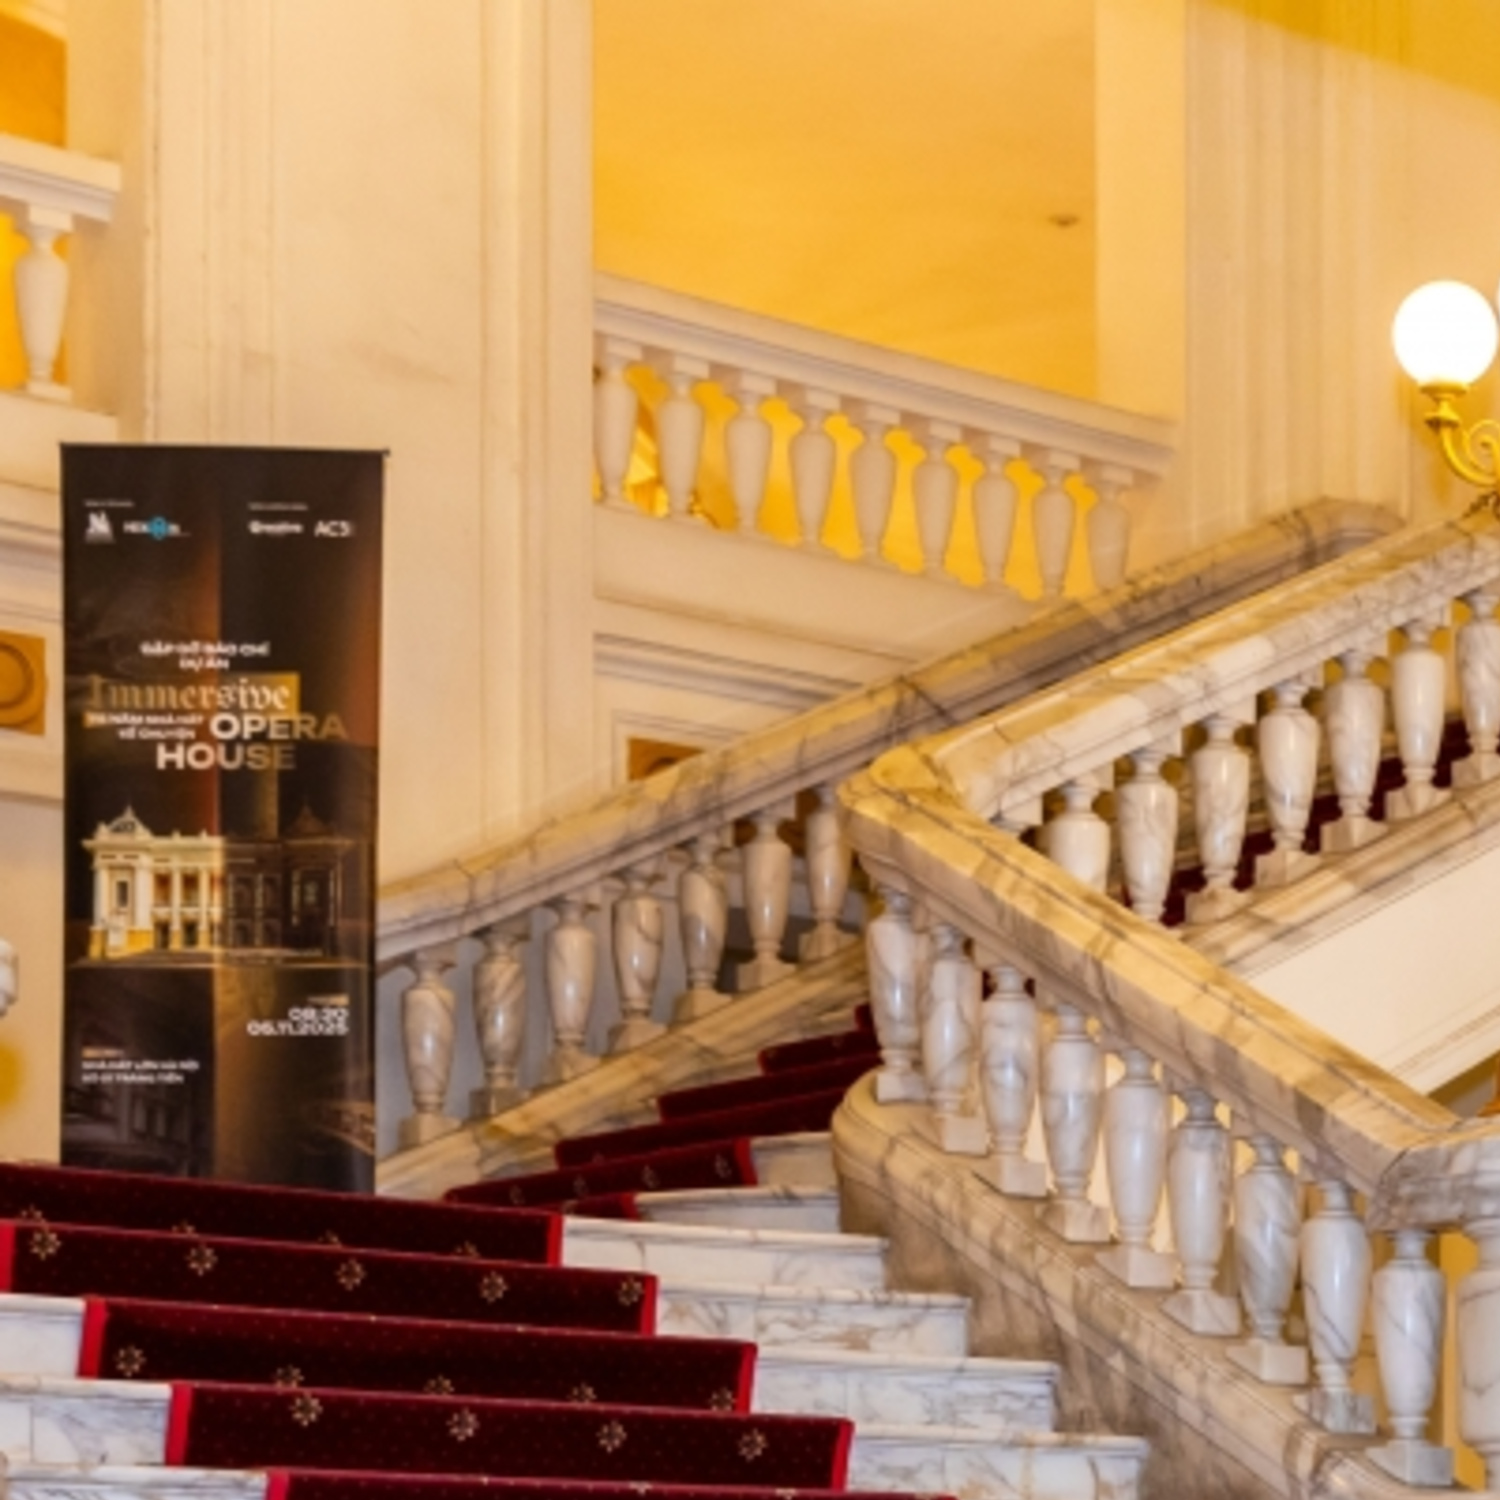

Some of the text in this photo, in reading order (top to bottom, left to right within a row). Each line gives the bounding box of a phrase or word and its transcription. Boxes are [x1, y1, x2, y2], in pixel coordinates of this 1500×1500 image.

[87, 673, 290, 710] Immersive
[209, 711, 348, 741] OPERA
[156, 742, 295, 770] HOUSE
